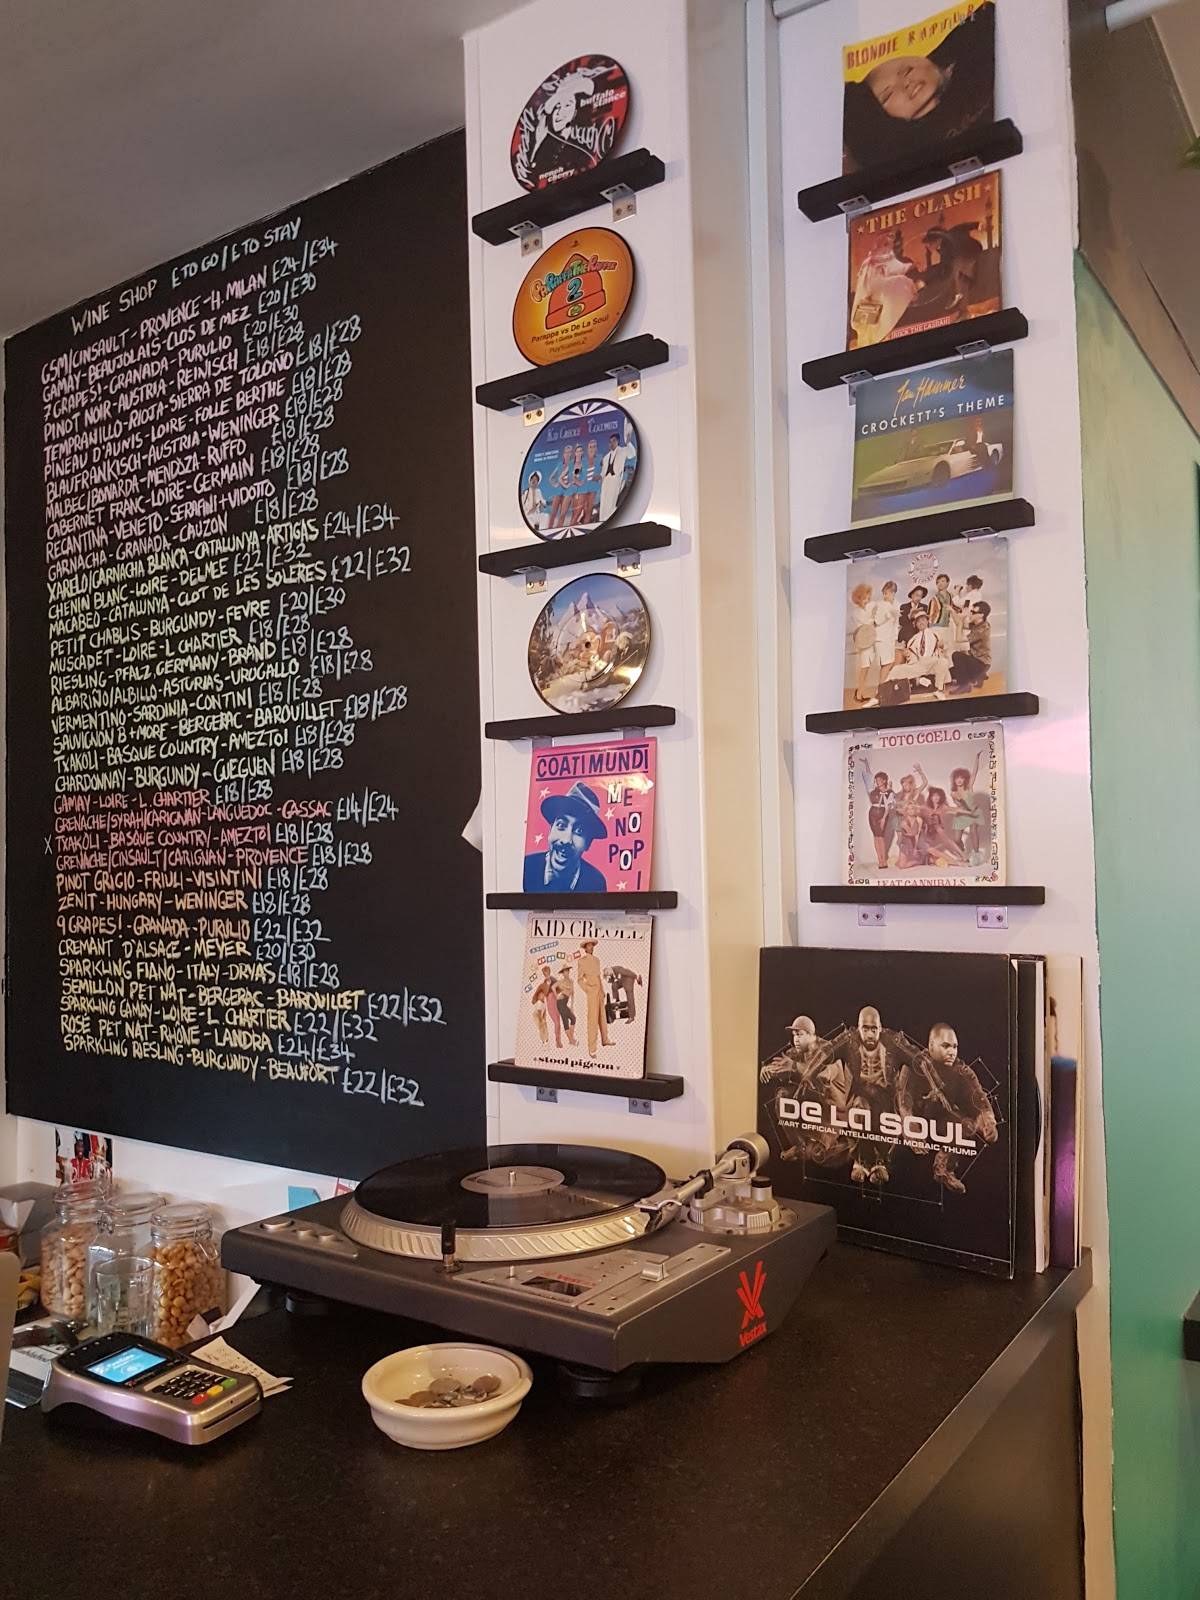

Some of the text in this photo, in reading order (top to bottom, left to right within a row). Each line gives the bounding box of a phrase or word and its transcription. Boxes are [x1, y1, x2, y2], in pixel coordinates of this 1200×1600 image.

[847, 36, 899, 70] BLONDIE
[866, 182, 982, 234] THE CLASH
[71, 301, 110, 335] WINE
[119, 279, 157, 312] SHOP
[264, 217, 301, 248] STAY
[44, 412, 81, 443] PINOT
[861, 395, 1005, 435] CROCKETT'S THEME
[235, 572, 260, 596] LES
[50, 633, 87, 658] PETIT
[880, 729, 961, 748] TOTO COELO
[615, 812, 642, 837] NO
[56, 872, 92, 896] PINOT
[534, 919, 565, 937] KID
[538, 1056, 615, 1071] stool pigeon
[801, 1123, 838, 1135] OFFICIAL
[903, 1139, 941, 1152] MOSAIC
[942, 1144, 978, 1157] THUMP
[879, 1111, 977, 1148] SOUL
